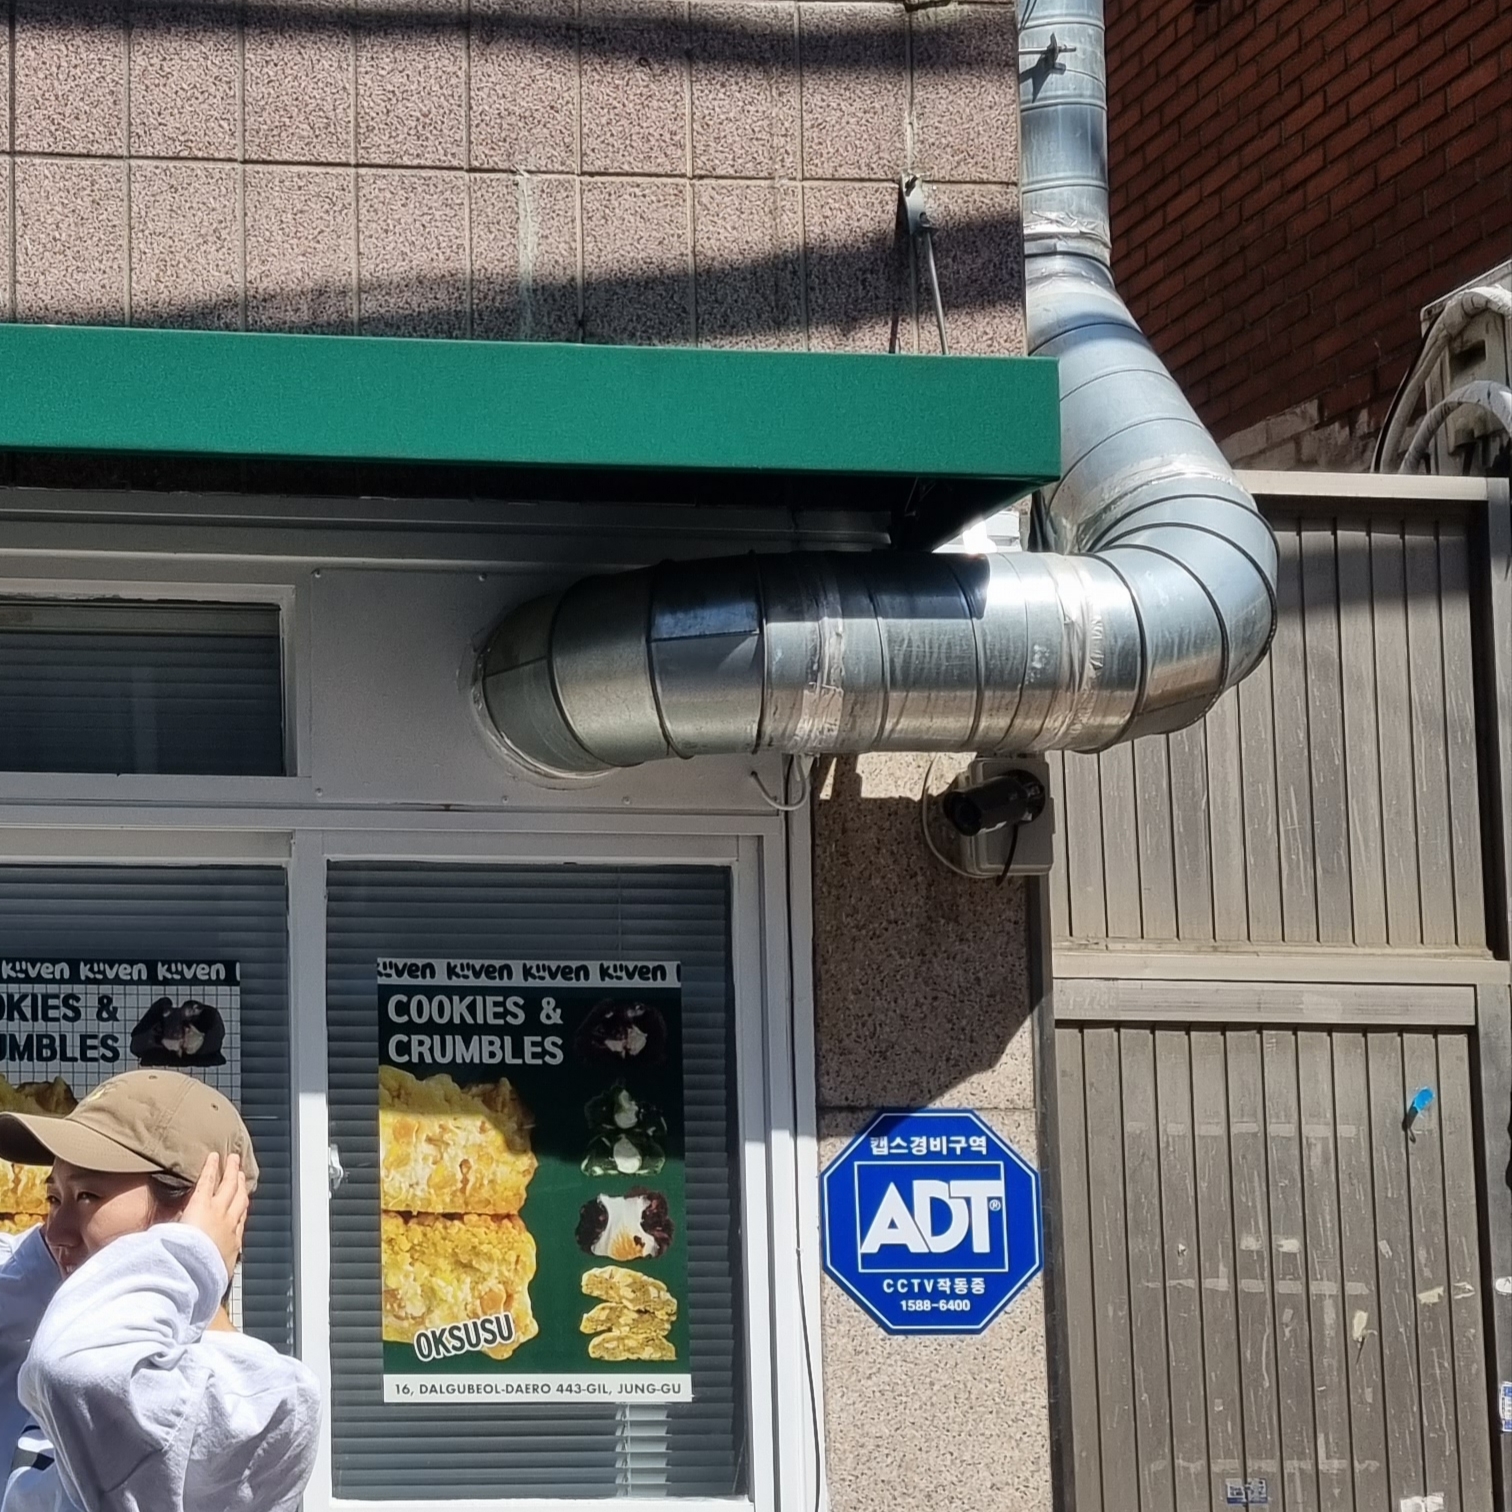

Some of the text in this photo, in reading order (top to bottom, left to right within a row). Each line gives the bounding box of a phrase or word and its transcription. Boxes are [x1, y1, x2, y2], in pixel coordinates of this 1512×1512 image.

[96, 995, 120, 1023] &
[388, 994, 564, 1025] COOKIES &
[388, 1034, 564, 1065] CRUMBLES
[870, 1136, 987, 1156] 캡스경비구역
[900, 1300, 971, 1311] 1588-6400
[416, 1314, 513, 1360] OKSUSU
[395, 1383, 681, 1396] 16, DALGUBEOL-DAERO 443-GIL, JUNG-GU
